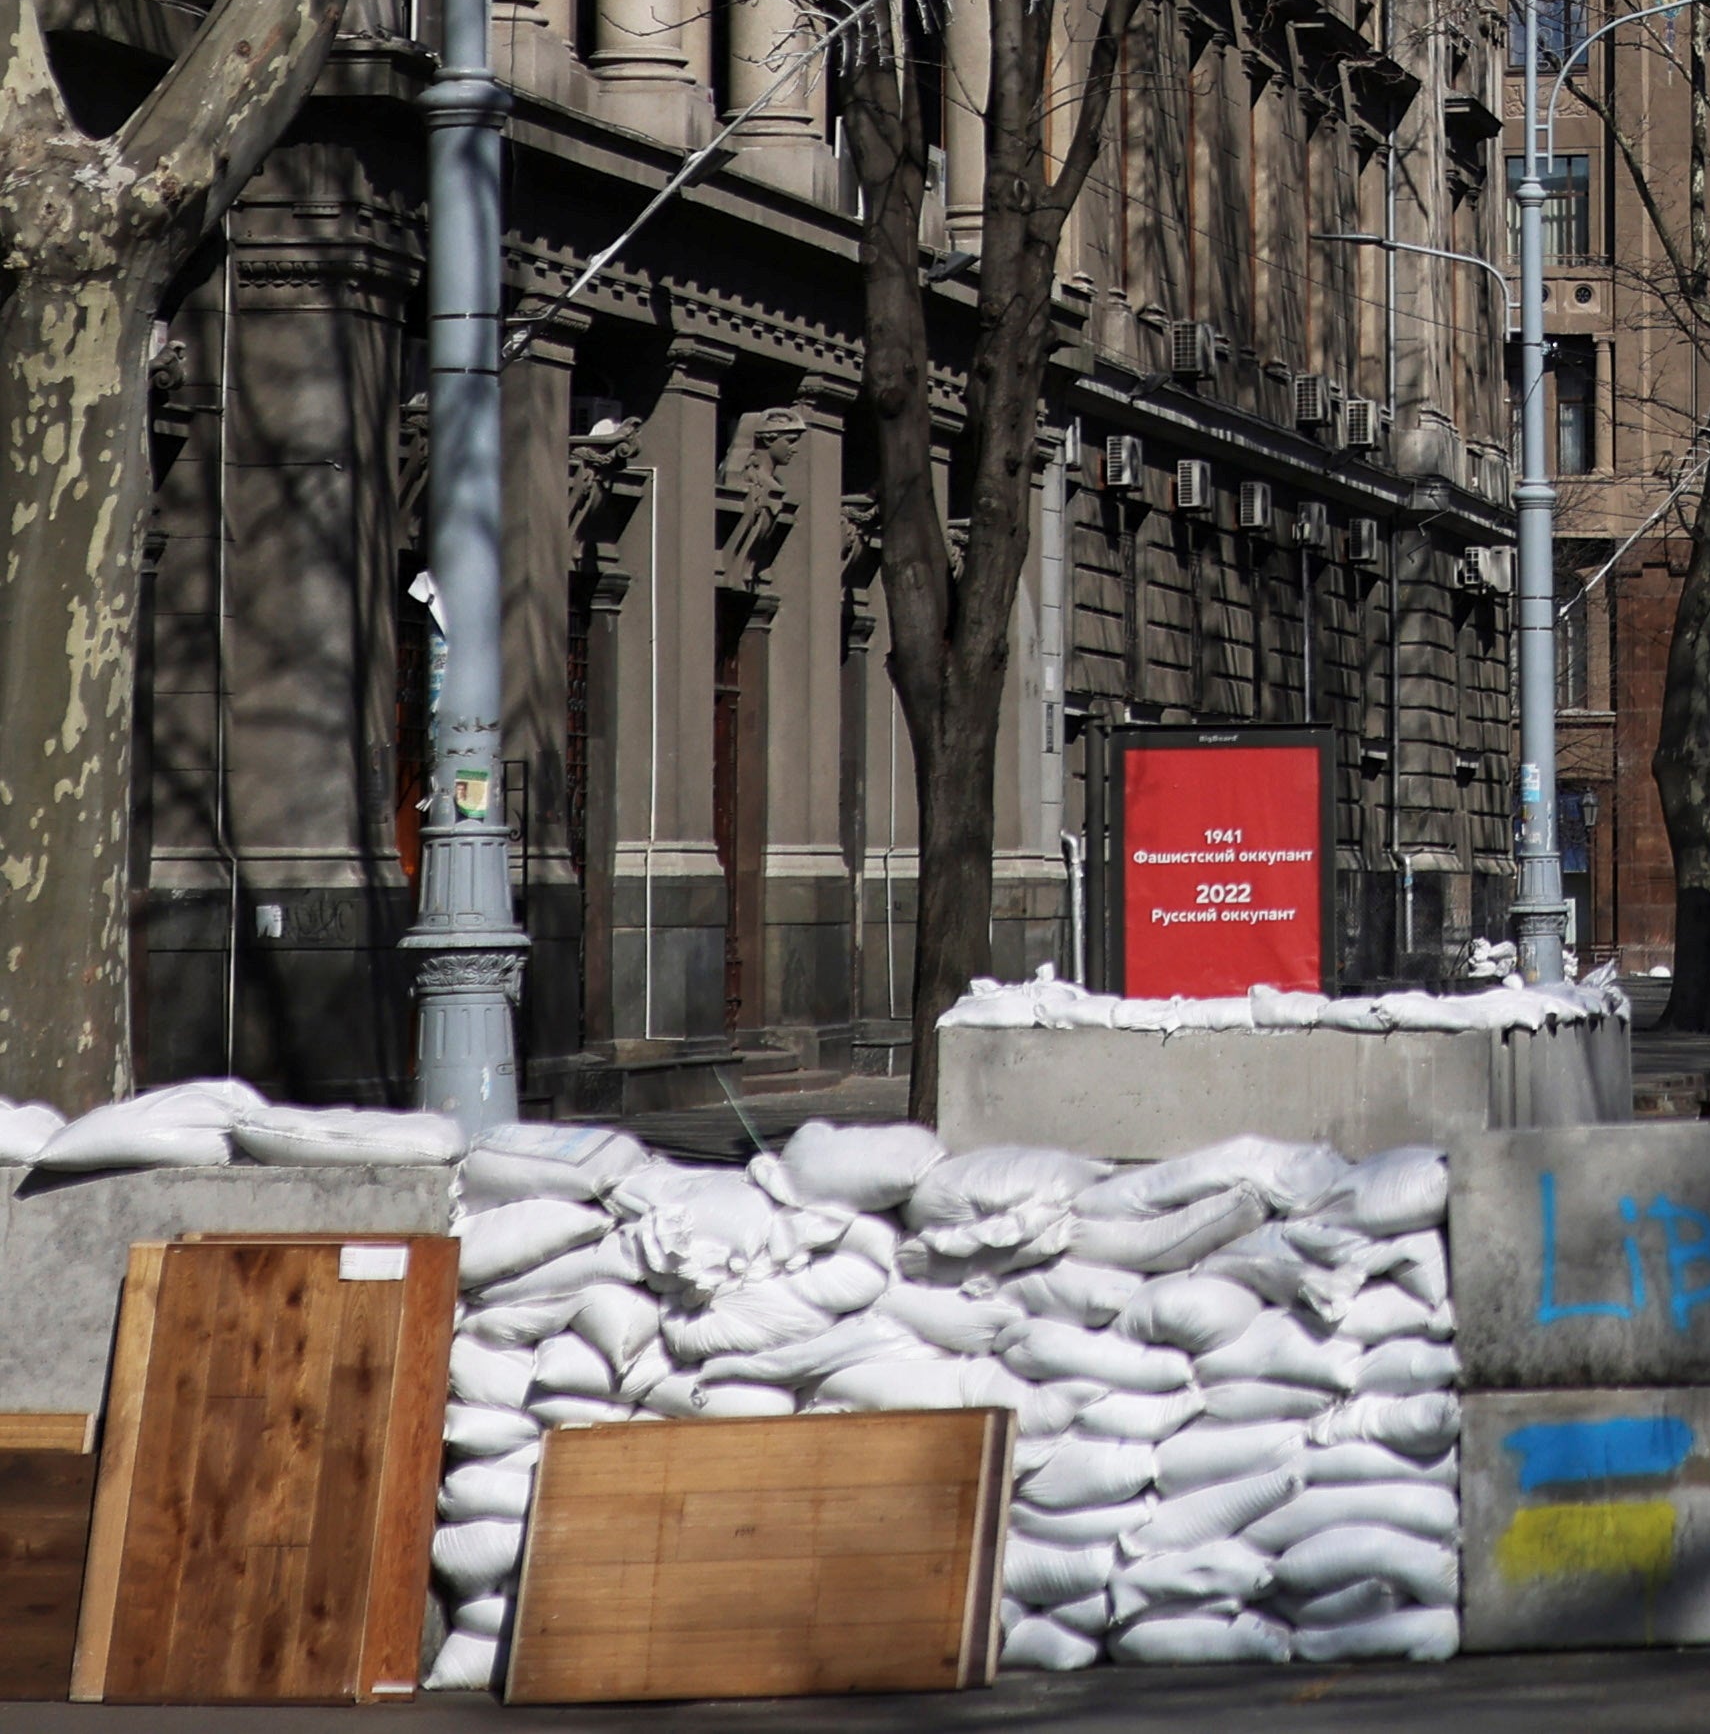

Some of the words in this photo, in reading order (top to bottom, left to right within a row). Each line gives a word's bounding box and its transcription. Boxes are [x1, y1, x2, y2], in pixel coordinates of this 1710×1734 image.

[1204, 829, 1242, 844] 1941
[1133, 849, 1235, 864] Фашистский
[1239, 850, 1313, 865] оккупант
[1195, 883, 1252, 904] 2022
[1151, 908, 1217, 926] Русский
[1220, 909, 1296, 925] оккупант
